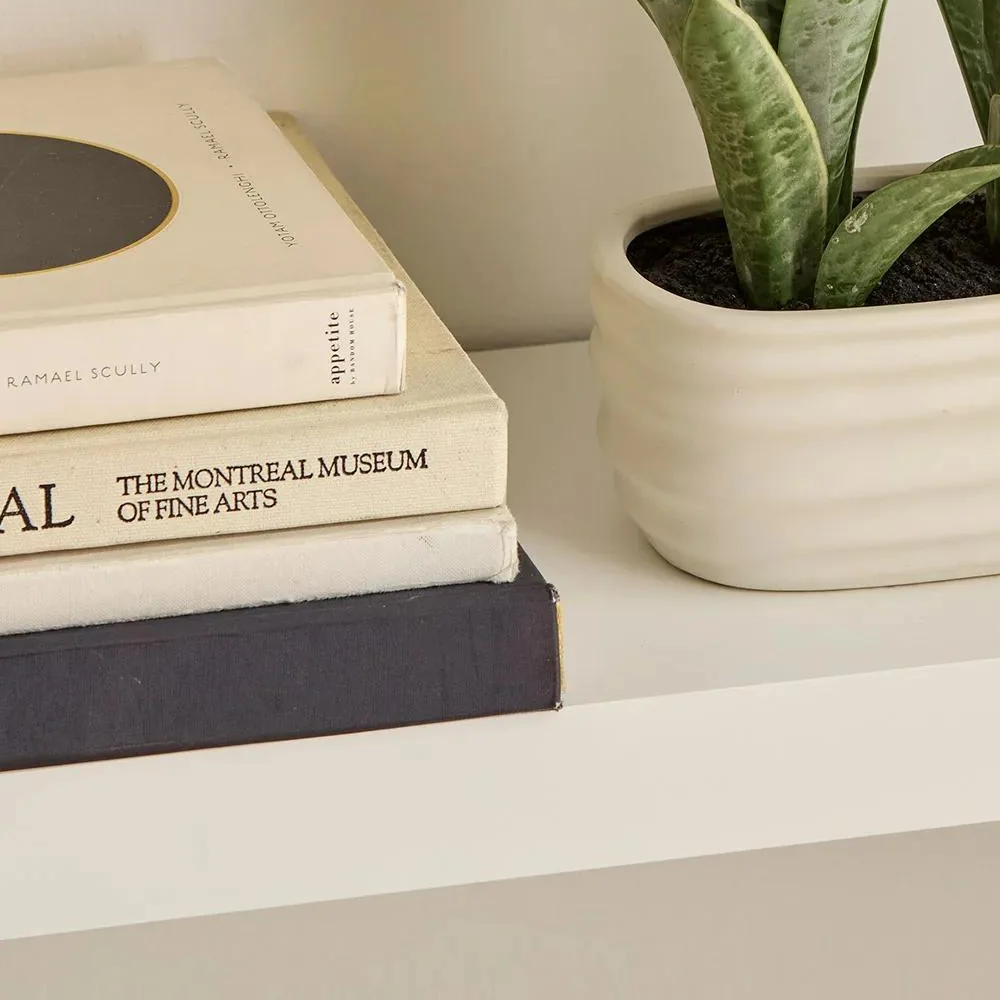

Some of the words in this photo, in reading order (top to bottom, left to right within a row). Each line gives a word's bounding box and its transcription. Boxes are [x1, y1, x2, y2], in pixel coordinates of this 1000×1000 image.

[176, 103, 207, 129] SCULLY
[200, 130, 231, 161] RAMAEL
[232, 172, 277, 220] OTTOLENGHI
[269, 220, 298, 248] YOTAM
[325, 311, 345, 384] appetite
[7, 369, 82, 388] RAMAEL
[91, 361, 161, 379] SCULLY
[116, 472, 168, 496] THE
[173, 459, 313, 491] MONTREAL
[318, 448, 429, 478] MUSEUM
[0, 483, 75, 534] AL
[117, 499, 151, 523] OF
[155, 494, 210, 521] FINE
[213, 488, 278, 514] ARTS
